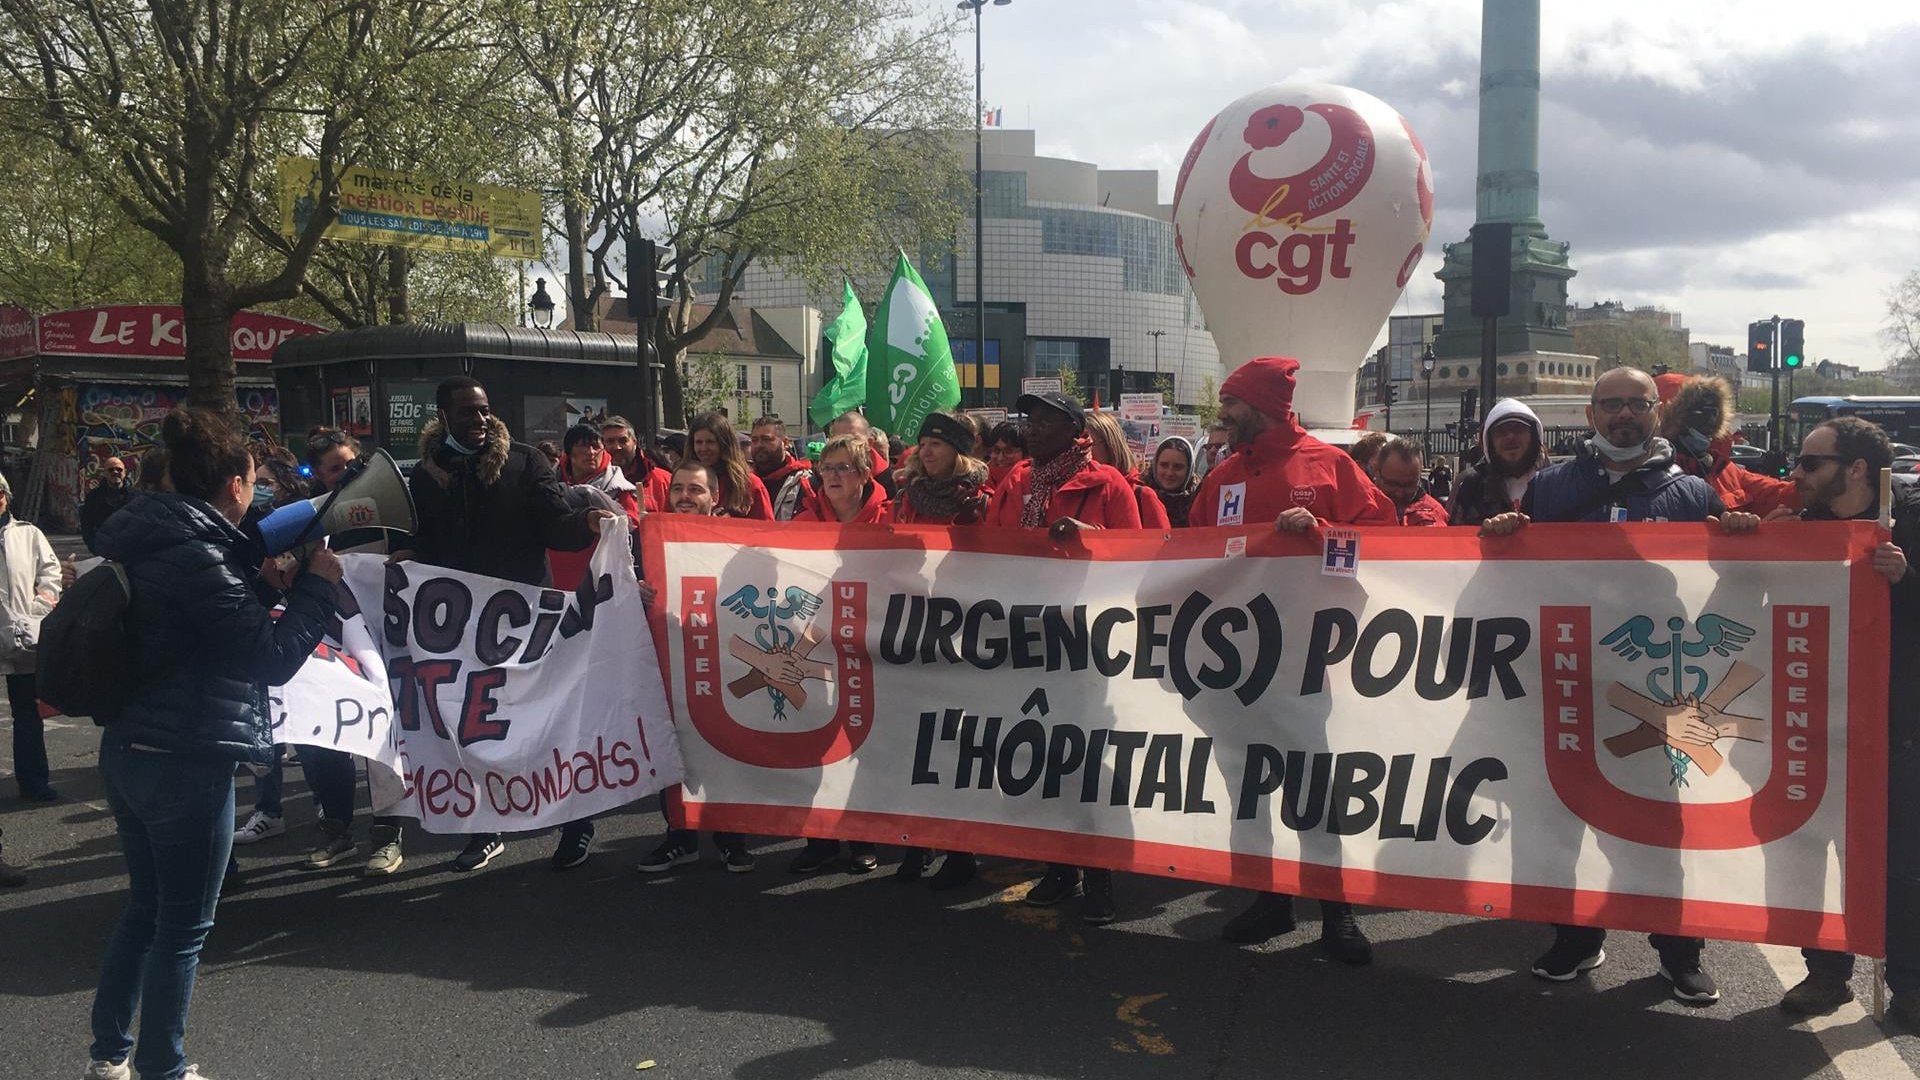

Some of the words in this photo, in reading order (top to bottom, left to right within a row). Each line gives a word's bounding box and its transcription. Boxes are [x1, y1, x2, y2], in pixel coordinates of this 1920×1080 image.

[354, 173, 426, 197] marché
[431, 180, 452, 200] de
[1308, 181, 1347, 211] ACTION
[1344, 137, 1370, 184] SOCIALE
[343, 213, 366, 224] TOUS
[368, 216, 386, 227] LES
[1235, 219, 1356, 295] cgt
[88, 311, 138, 345] LE
[390, 403, 422, 418] 150€
[691, 590, 713, 696] INTER
[839, 586, 864, 727] URGENCES
[880, 590, 1283, 707] URGENCE(S)
[1300, 607, 1531, 701] POUR
[1554, 623, 1582, 752] INTER
[1785, 611, 1809, 800] URGENCES
[911, 687, 1216, 814] L'HÔPITAL
[1236, 743, 1508, 846] PUBLIC
